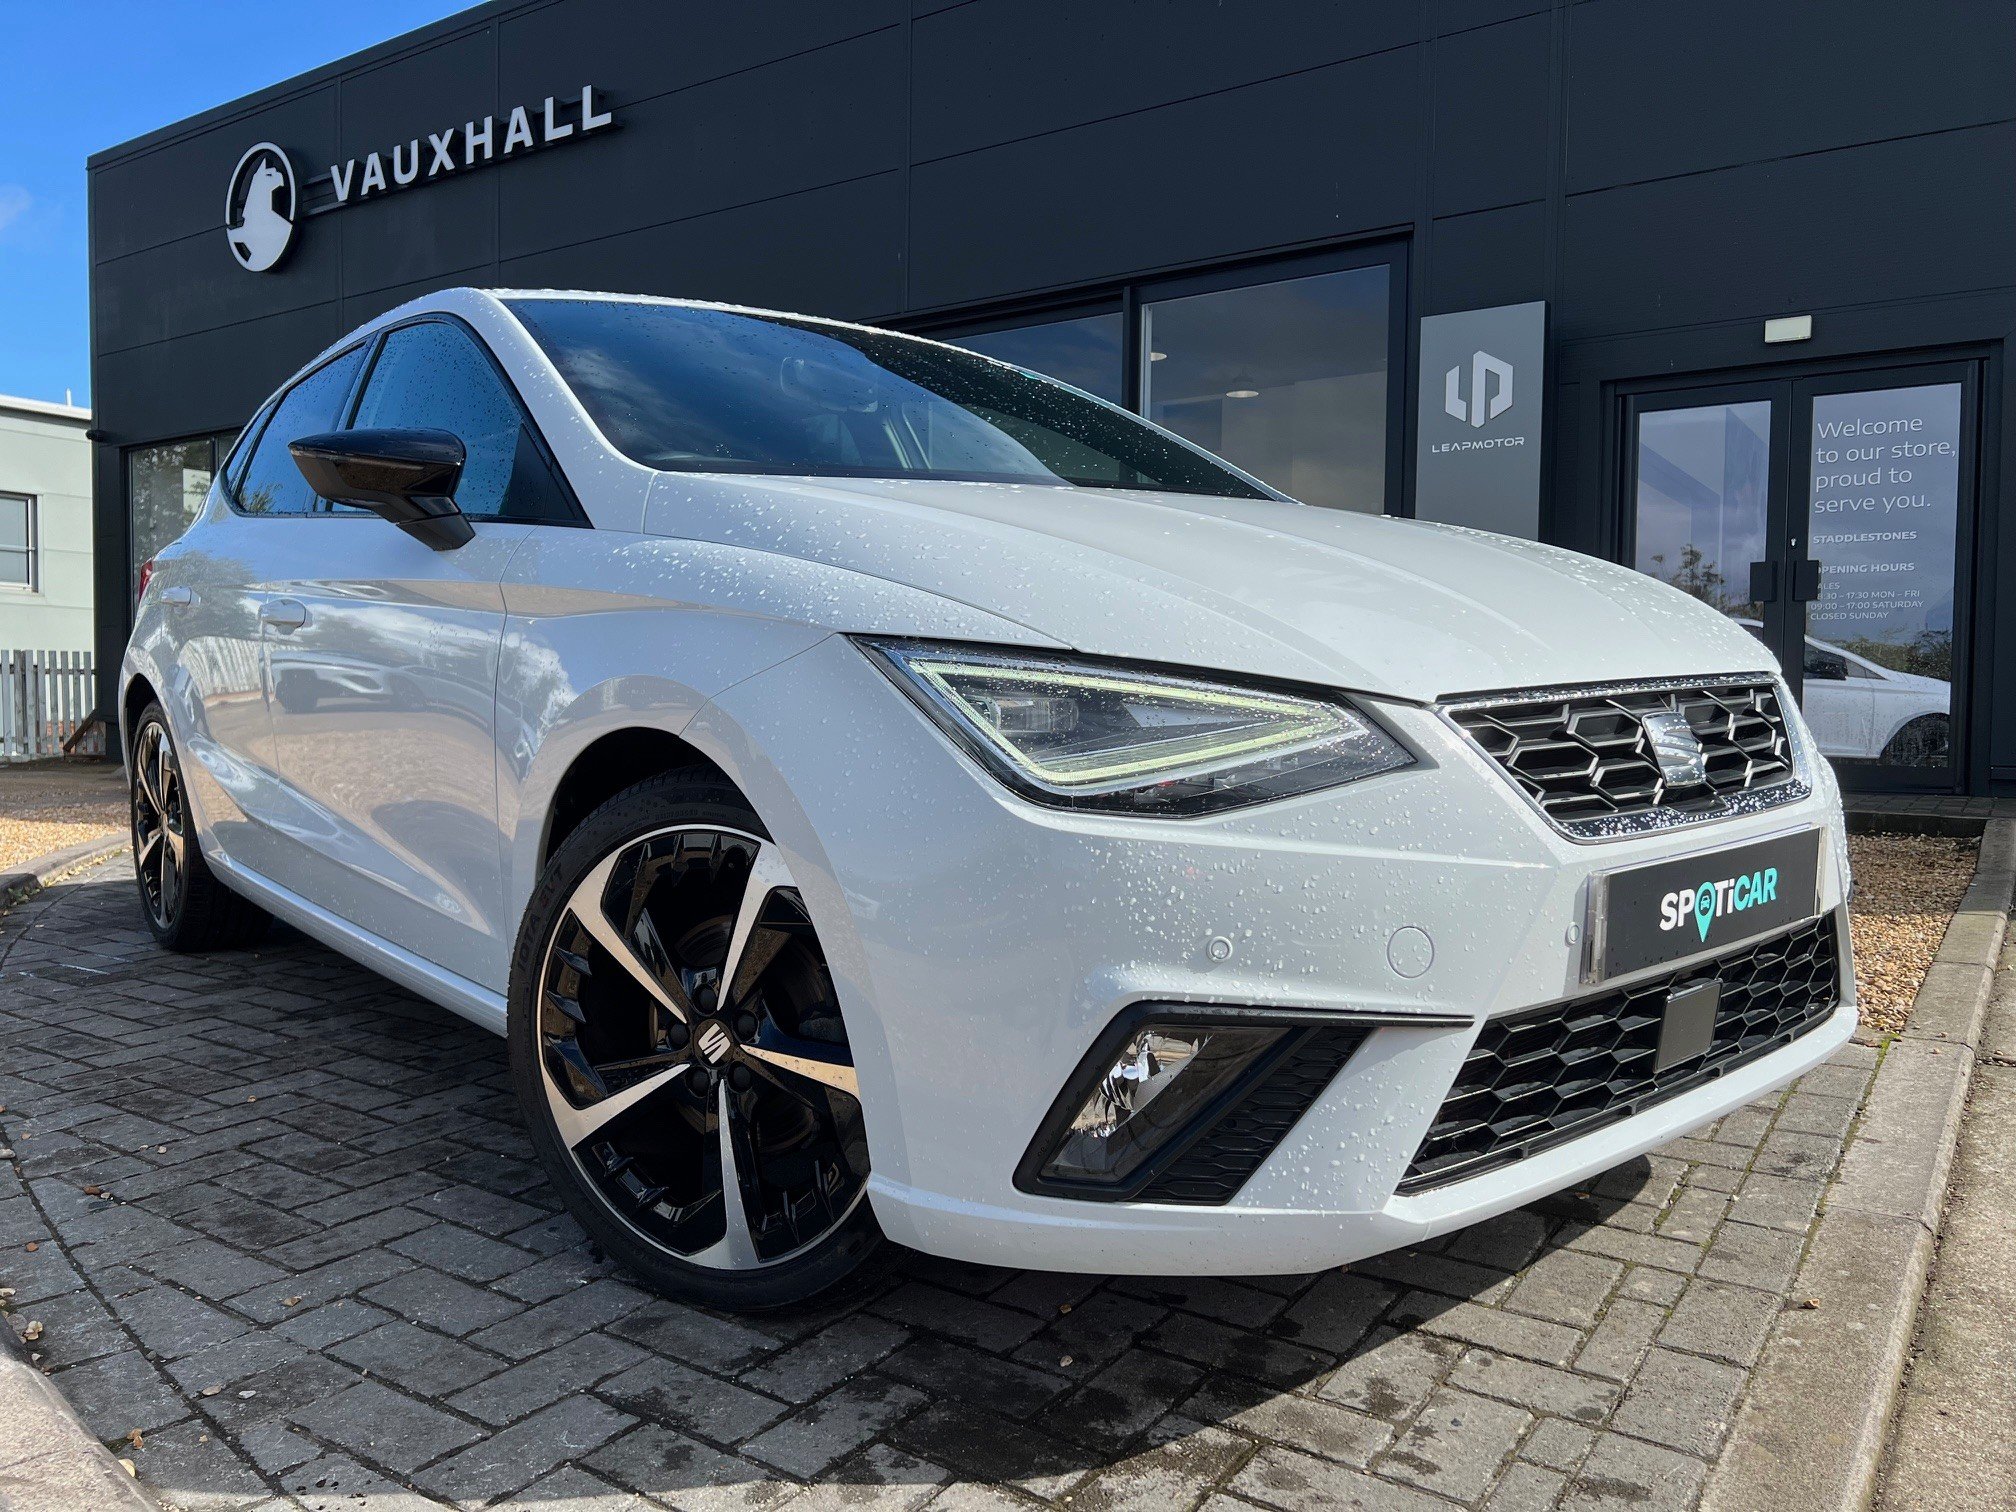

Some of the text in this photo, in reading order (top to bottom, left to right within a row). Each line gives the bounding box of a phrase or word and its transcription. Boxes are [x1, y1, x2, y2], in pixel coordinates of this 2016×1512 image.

[330, 84, 612, 202] VAUXHALL
[1817, 418, 1923, 439] Welcome
[1432, 436, 1525, 453] LEAPMOTOR
[1816, 441, 1956, 464] to our store,
[1815, 467, 1913, 493] proud to
[1814, 494, 1931, 514] serve you.
[1813, 531, 1918, 544] STADDLESTONES
[1870, 562, 1915, 573] HOURS
[1871, 590, 1896, 599] MON
[1904, 589, 1920, 598] FRI
[1872, 600, 1924, 609] SATURDAY
[1810, 611, 1890, 620] CLOSED SUNDAY
